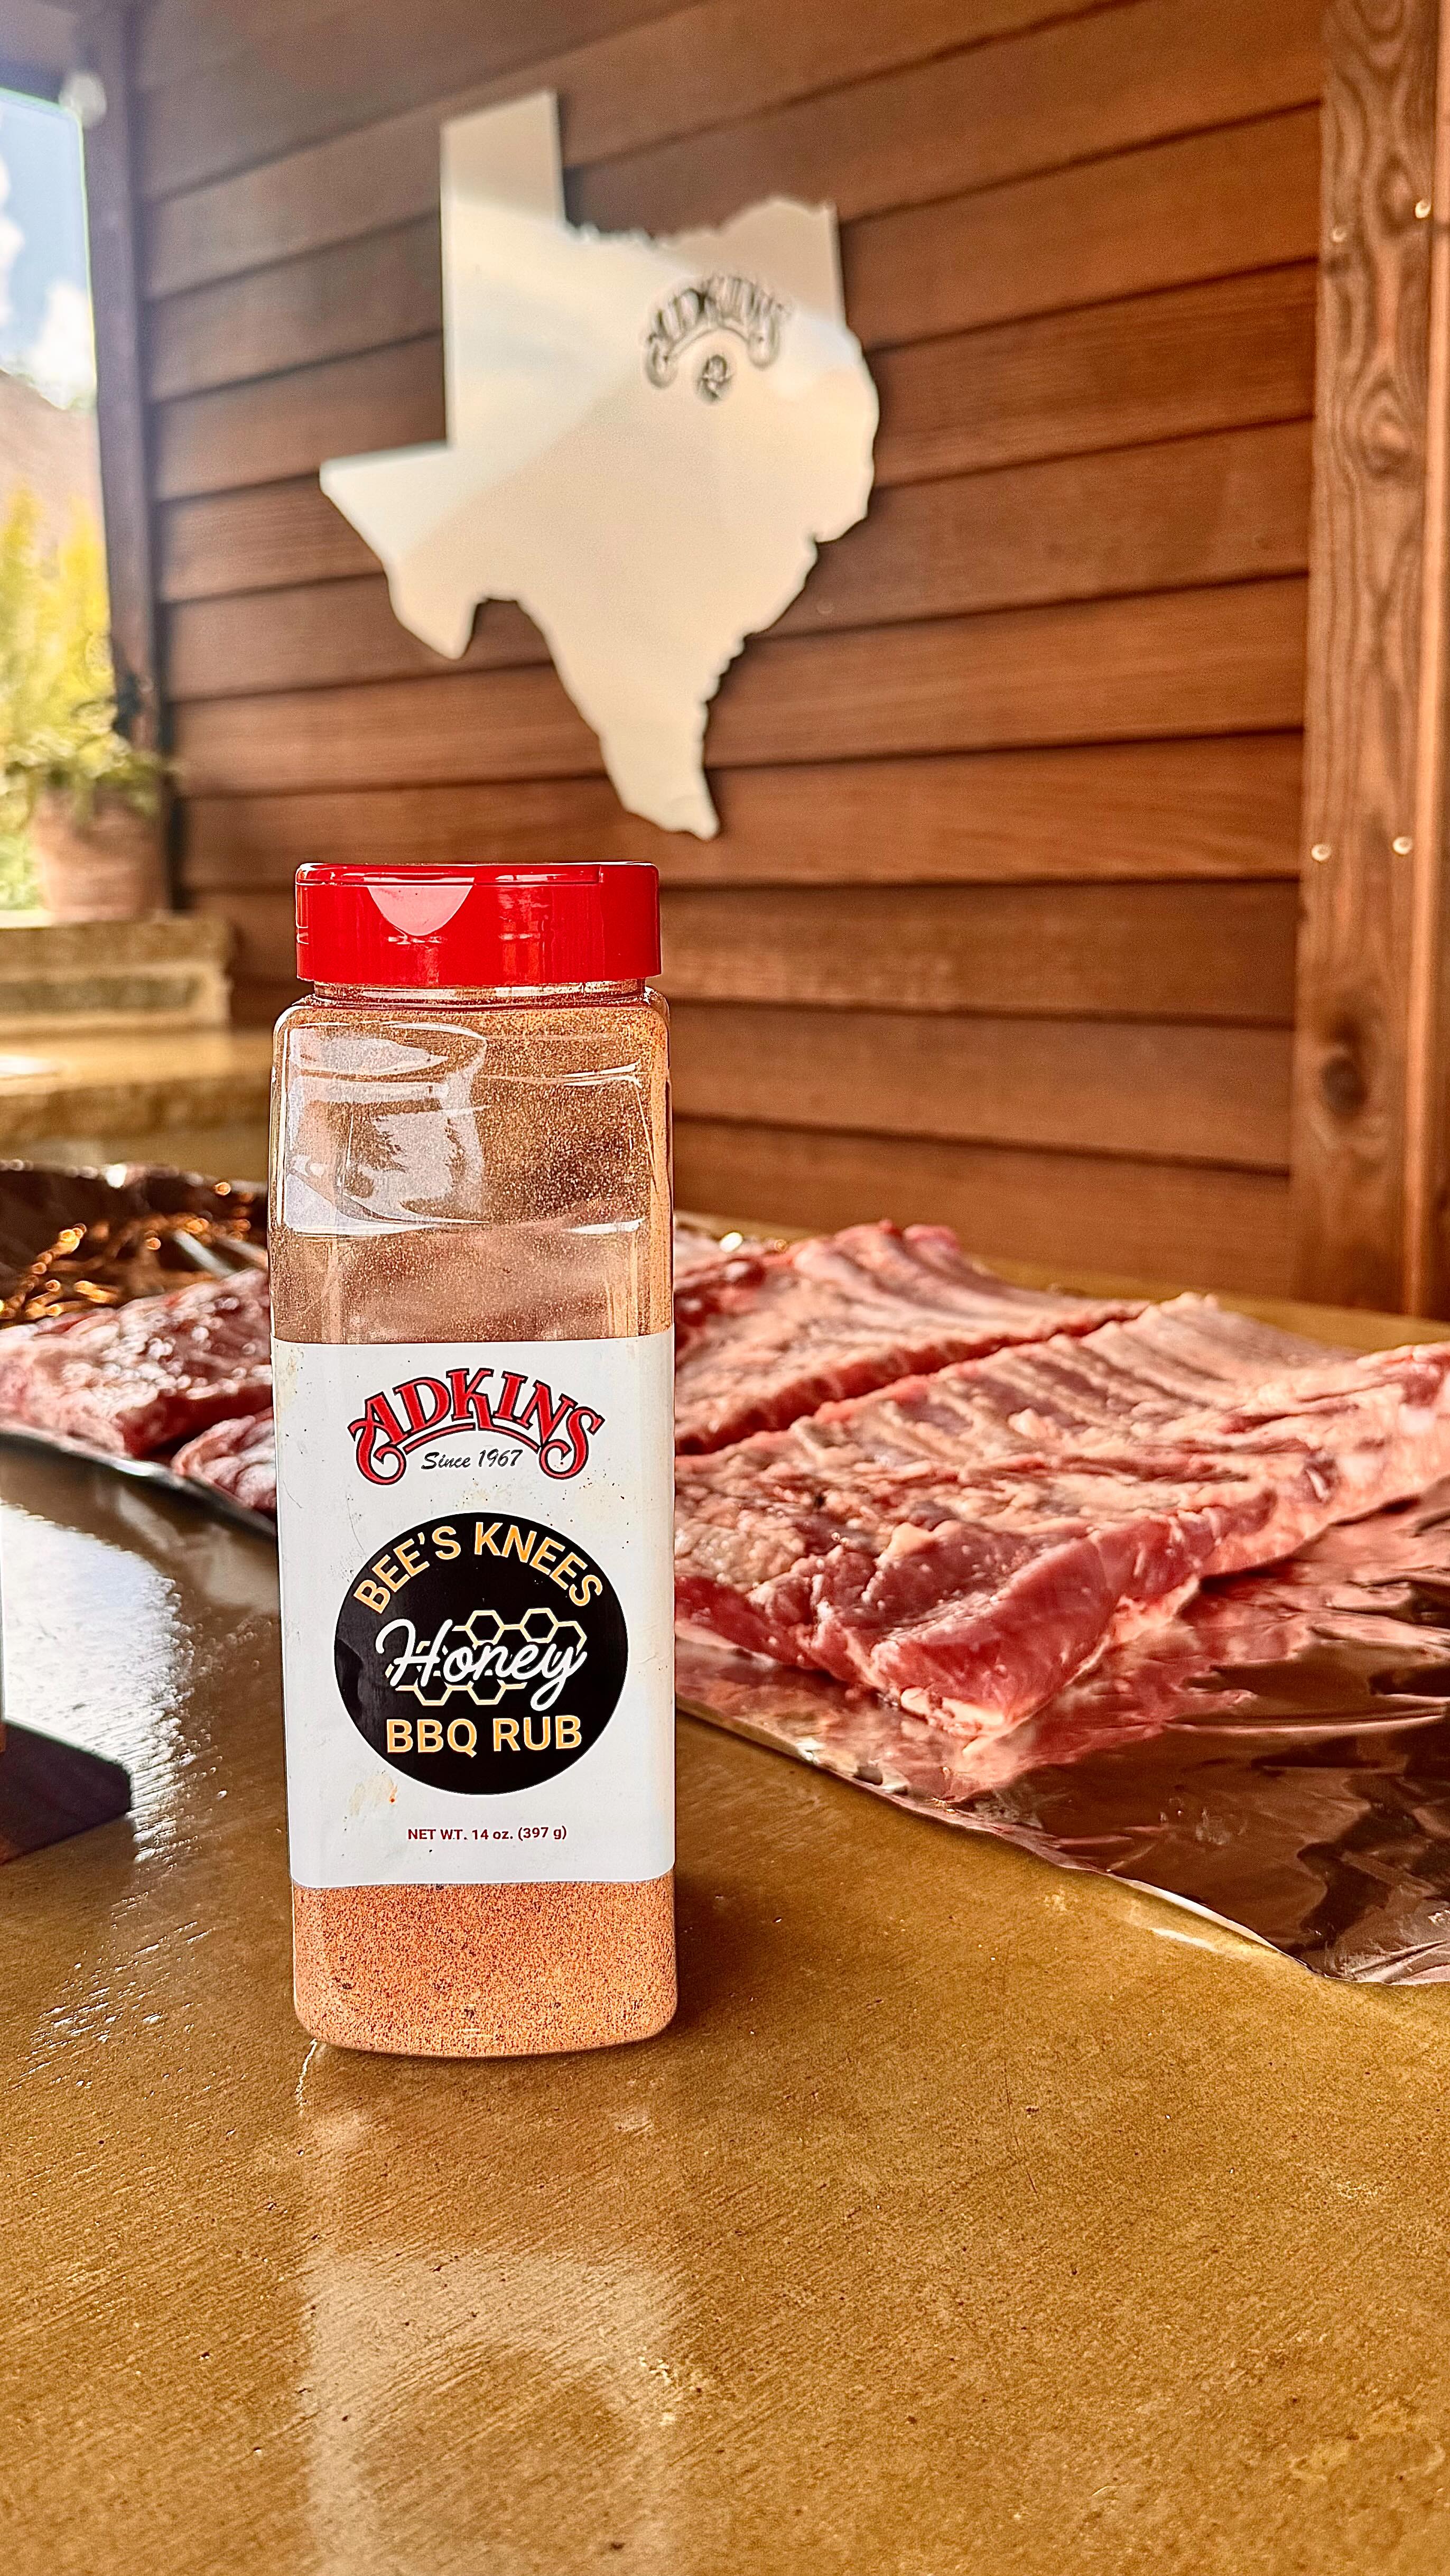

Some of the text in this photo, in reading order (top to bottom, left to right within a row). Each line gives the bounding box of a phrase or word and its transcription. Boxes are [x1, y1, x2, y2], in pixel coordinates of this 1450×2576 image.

[347, 1367, 606, 1486] ADKINS
[421, 1449, 524, 1470] Since 1967
[353, 1522, 603, 1614] BEE'S KNEES
[375, 1619, 588, 1711] Honey
[386, 1714, 582, 1758] BBQ RUB
[407, 1826, 568, 1841] NET WT. 14 oz. (397 g)
